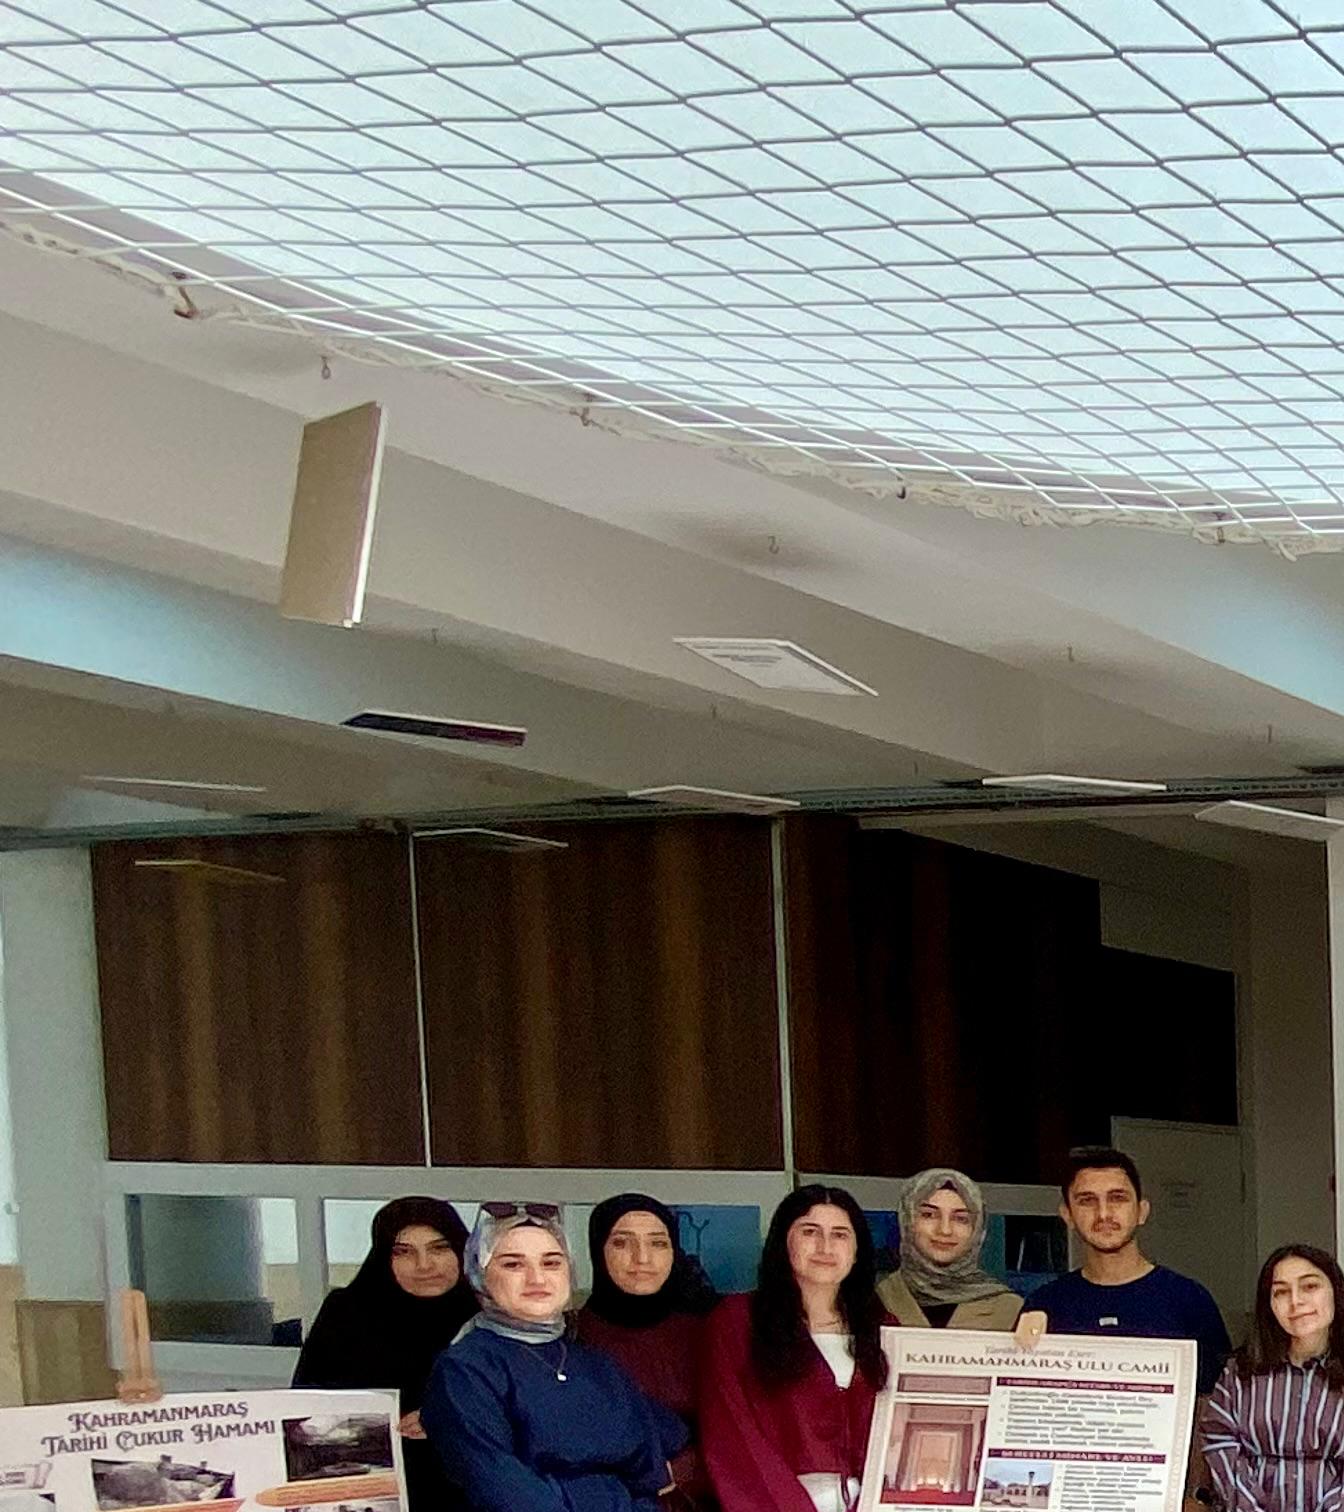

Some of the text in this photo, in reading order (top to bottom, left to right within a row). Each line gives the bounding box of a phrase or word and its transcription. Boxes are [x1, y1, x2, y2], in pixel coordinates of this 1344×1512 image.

[906, 1353, 1073, 1371] KAHRAMANMARAŞ
[1077, 1360, 1114, 1371] ULU
[68, 1401, 249, 1433] KAHRAMANMARAŞ
[40, 1434, 108, 1458] TARİHİ
[190, 1420, 276, 1445] HAMAMI
